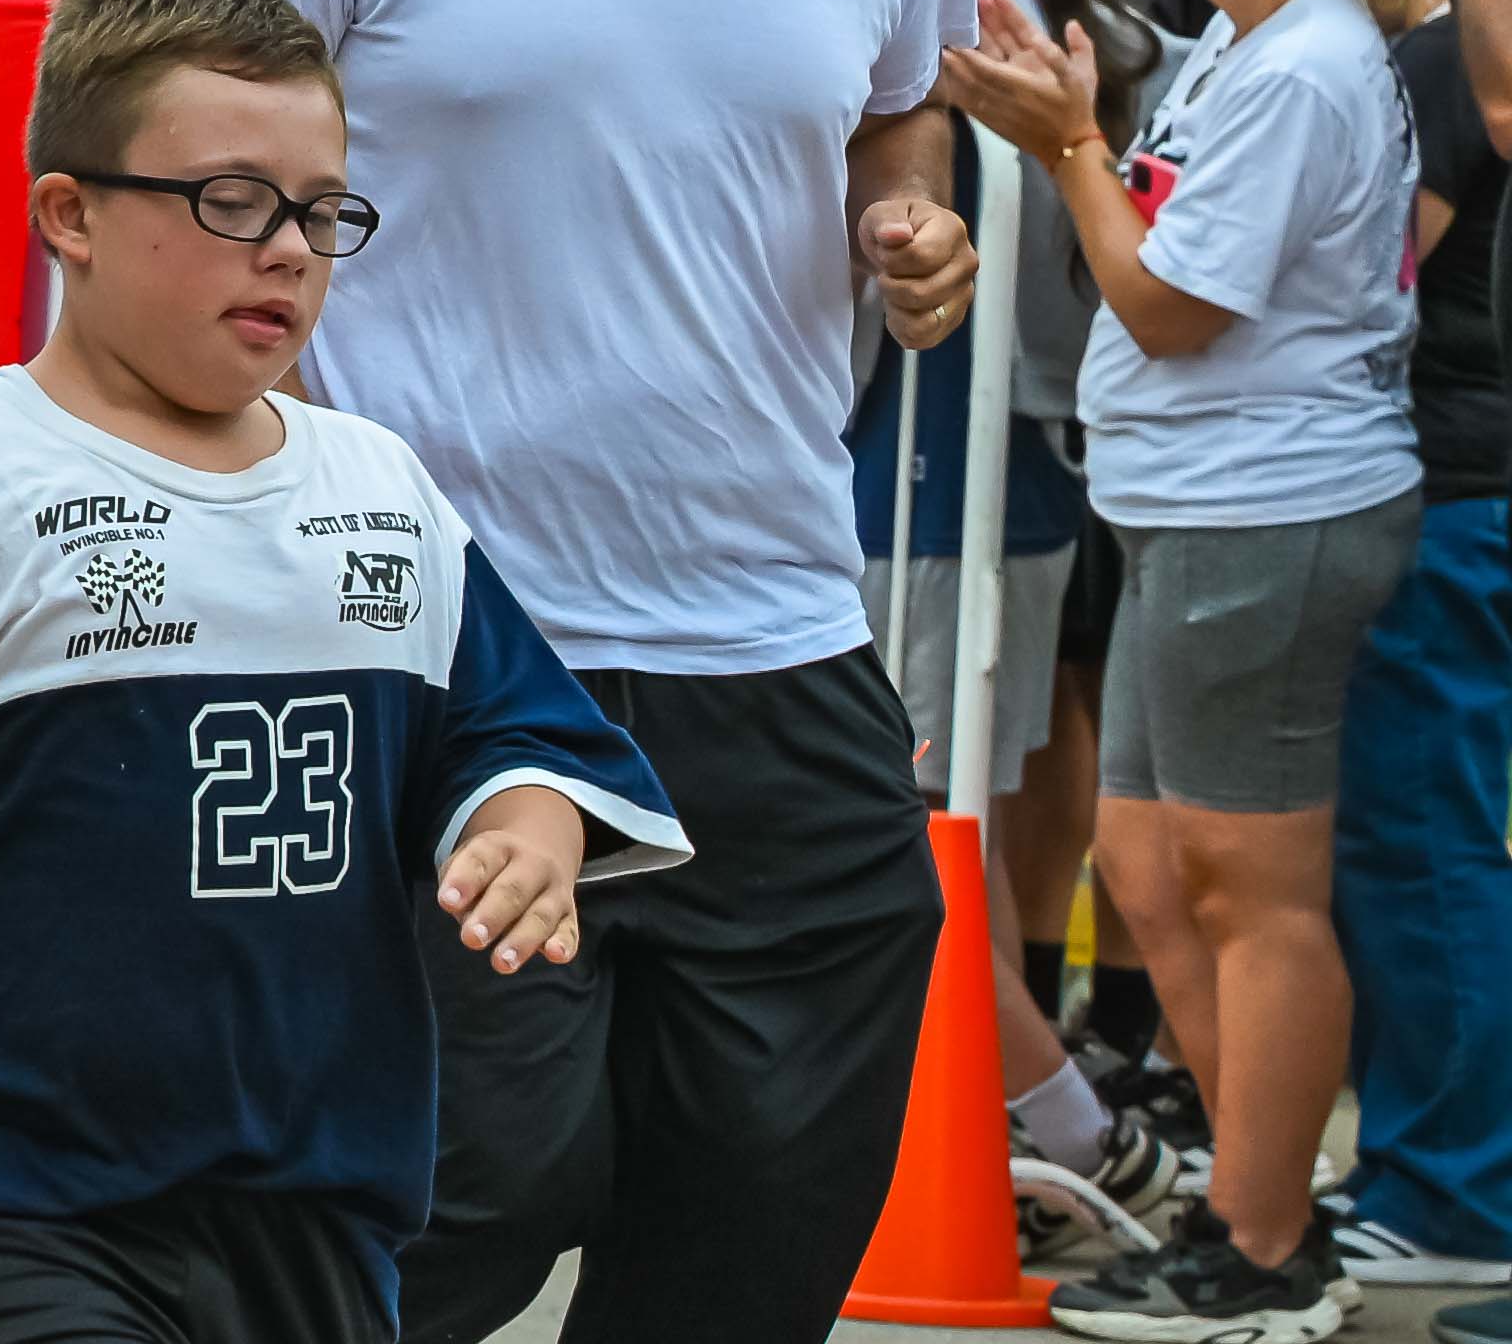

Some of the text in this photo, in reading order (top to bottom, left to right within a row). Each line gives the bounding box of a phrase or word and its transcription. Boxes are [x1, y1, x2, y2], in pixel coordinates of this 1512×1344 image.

[33, 495, 173, 539] WORLD
[59, 527, 166, 556] INVINCIBLE NO.1
[64, 621, 198, 660] INVINCIBLE
[190, 693, 354, 899] 23
